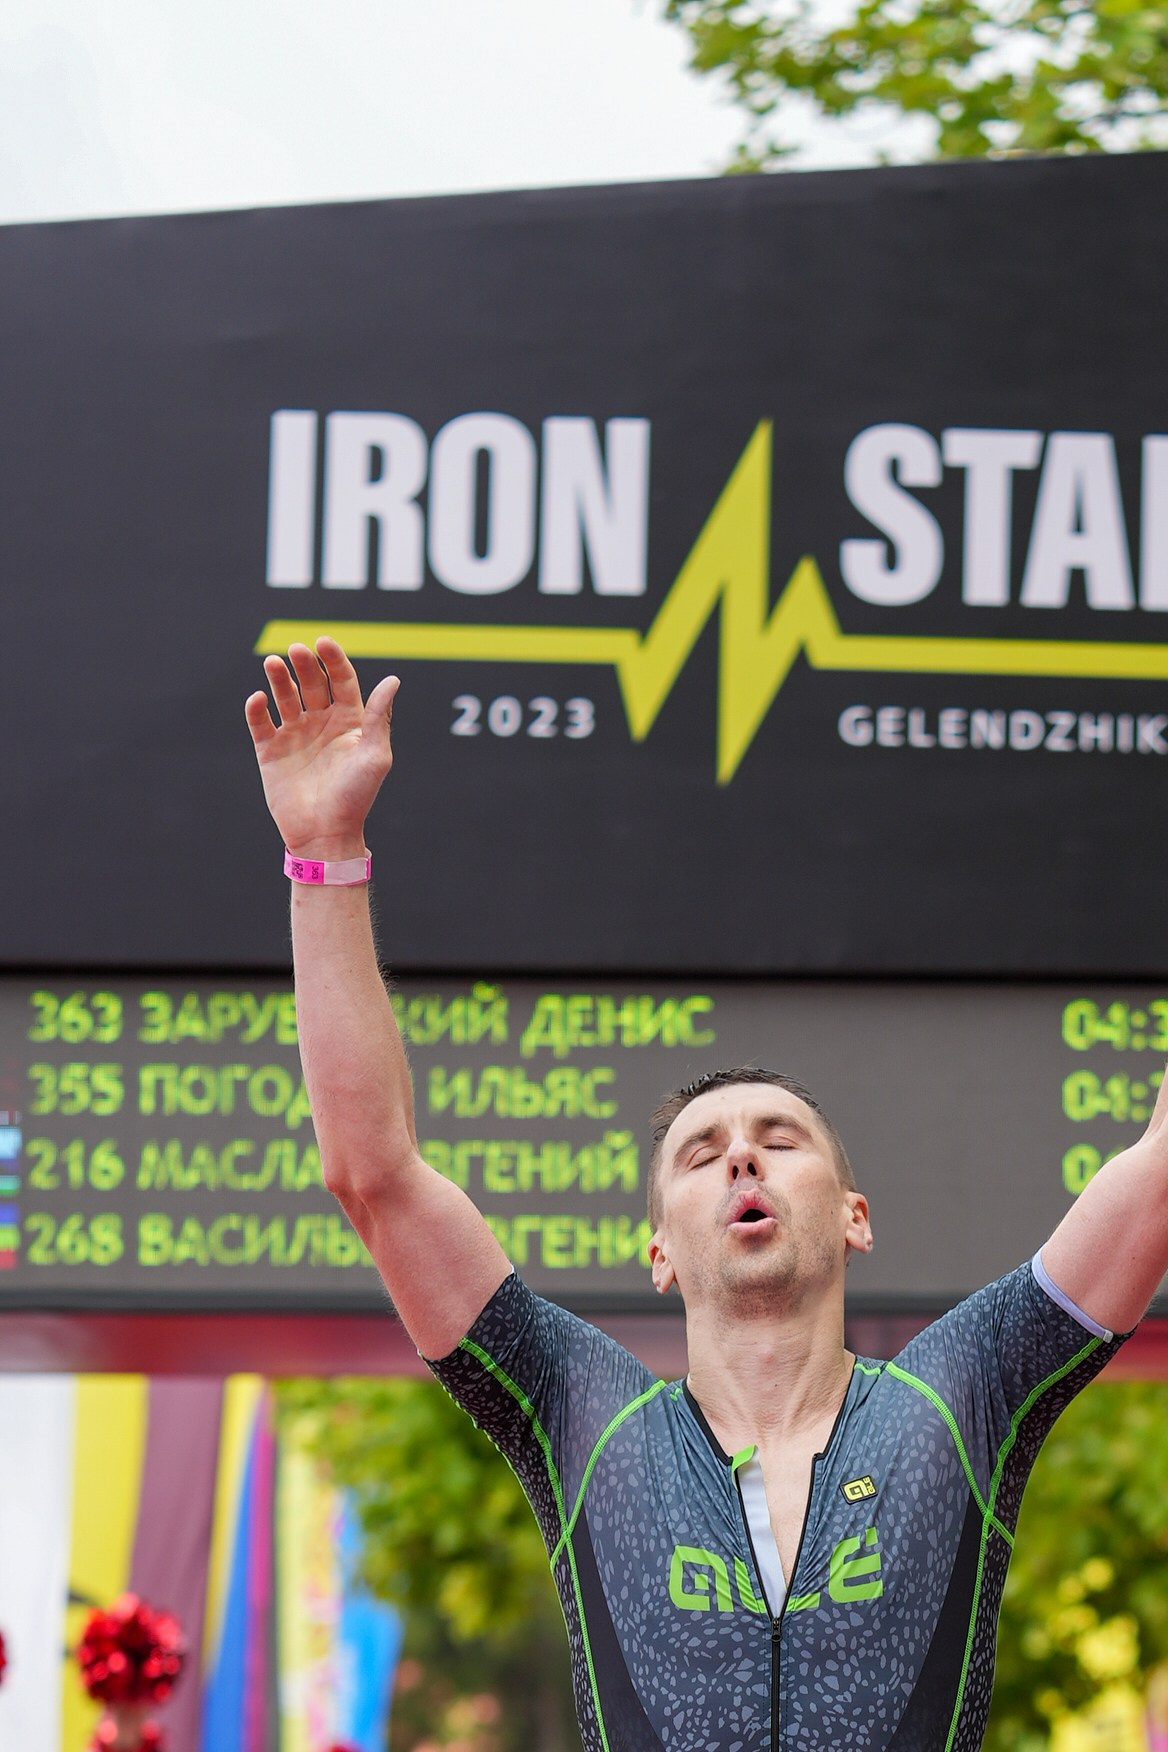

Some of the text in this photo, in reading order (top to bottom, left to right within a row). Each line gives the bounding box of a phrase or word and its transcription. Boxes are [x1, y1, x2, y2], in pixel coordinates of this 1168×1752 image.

[265, 408, 650, 597] IRON
[450, 694, 596, 738] 2023
[27, 990, 124, 1043] 363
[520, 994, 716, 1059] ДЕНИС
[27, 1062, 125, 1116] 355
[428, 1065, 618, 1118] ИЛЬЯС
[25, 1138, 126, 1191] 216
[25, 1212, 126, 1266] 268
